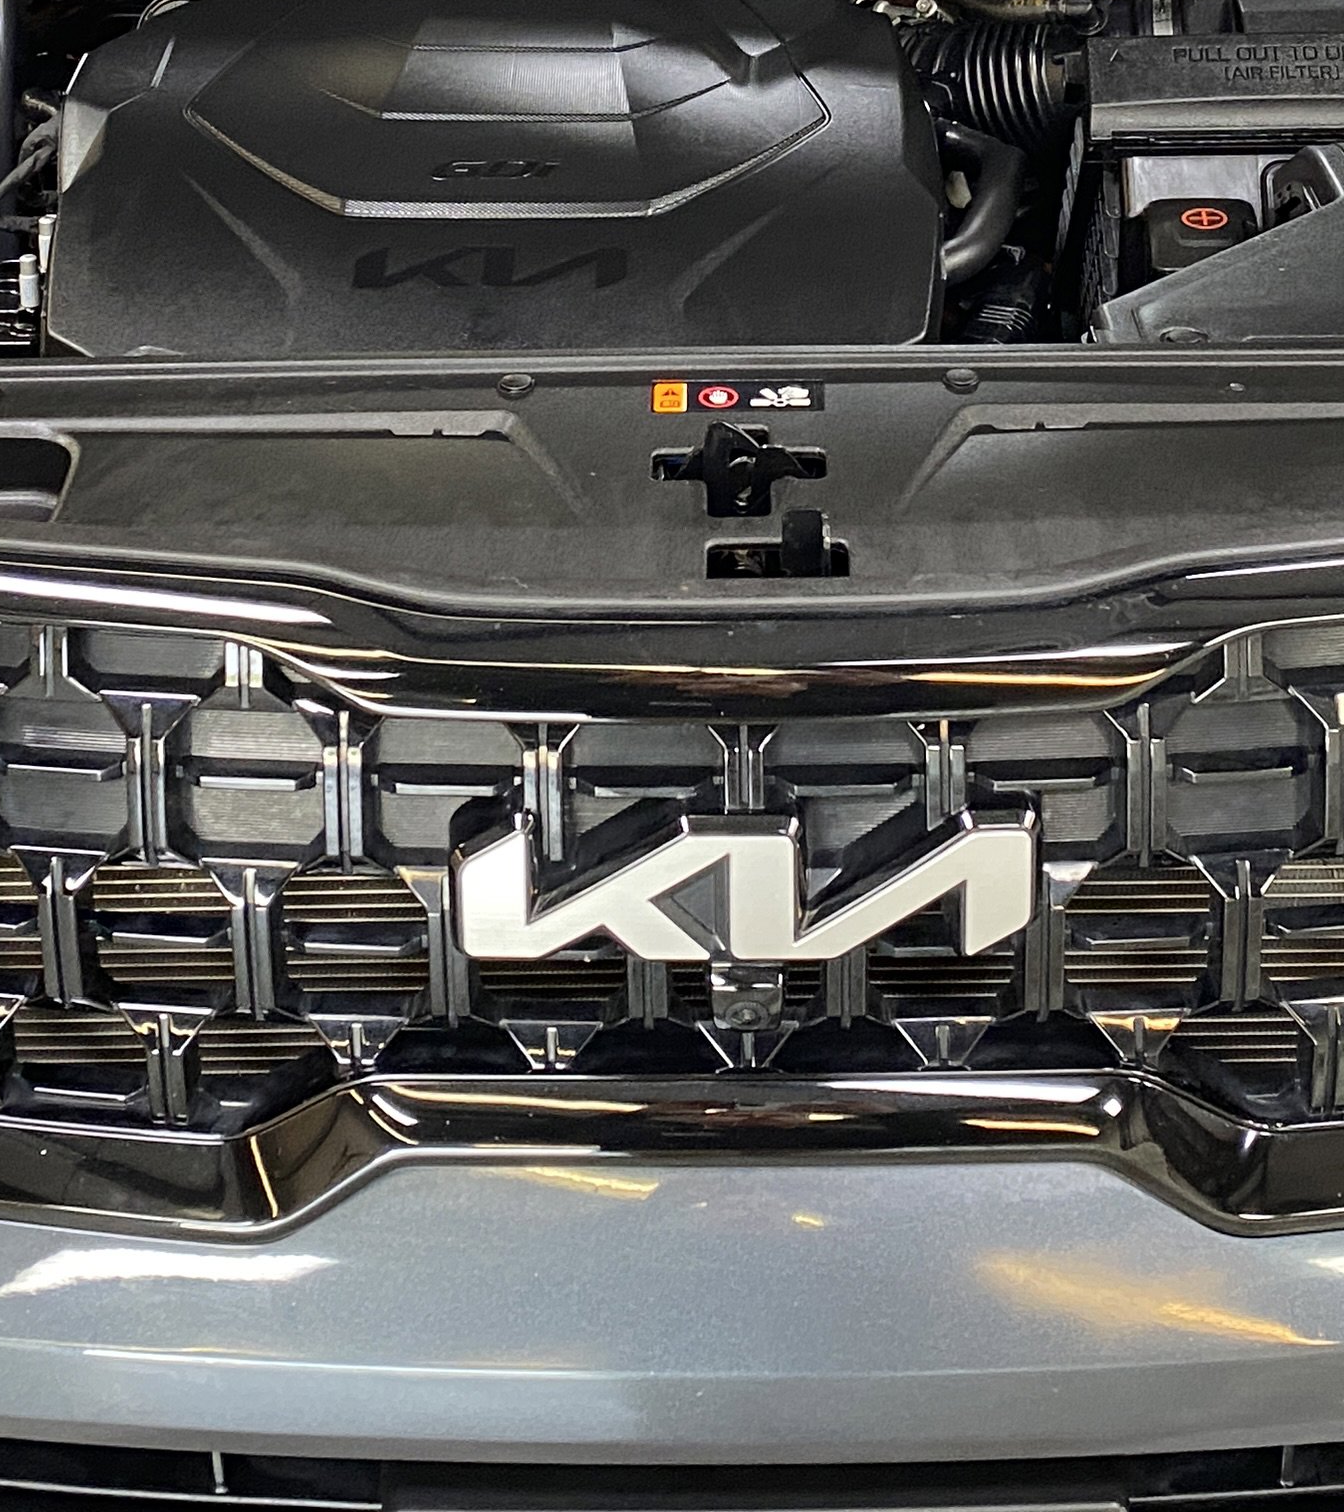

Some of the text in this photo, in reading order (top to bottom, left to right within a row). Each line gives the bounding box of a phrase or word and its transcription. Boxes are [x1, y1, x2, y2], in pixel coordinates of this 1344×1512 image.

[1172, 46, 1231, 63] PULL
[1236, 45, 1281, 62] OUT
[1291, 45, 1318, 62] TO
[352, 245, 628, 290] KIA
[458, 823, 1035, 961] KIA
